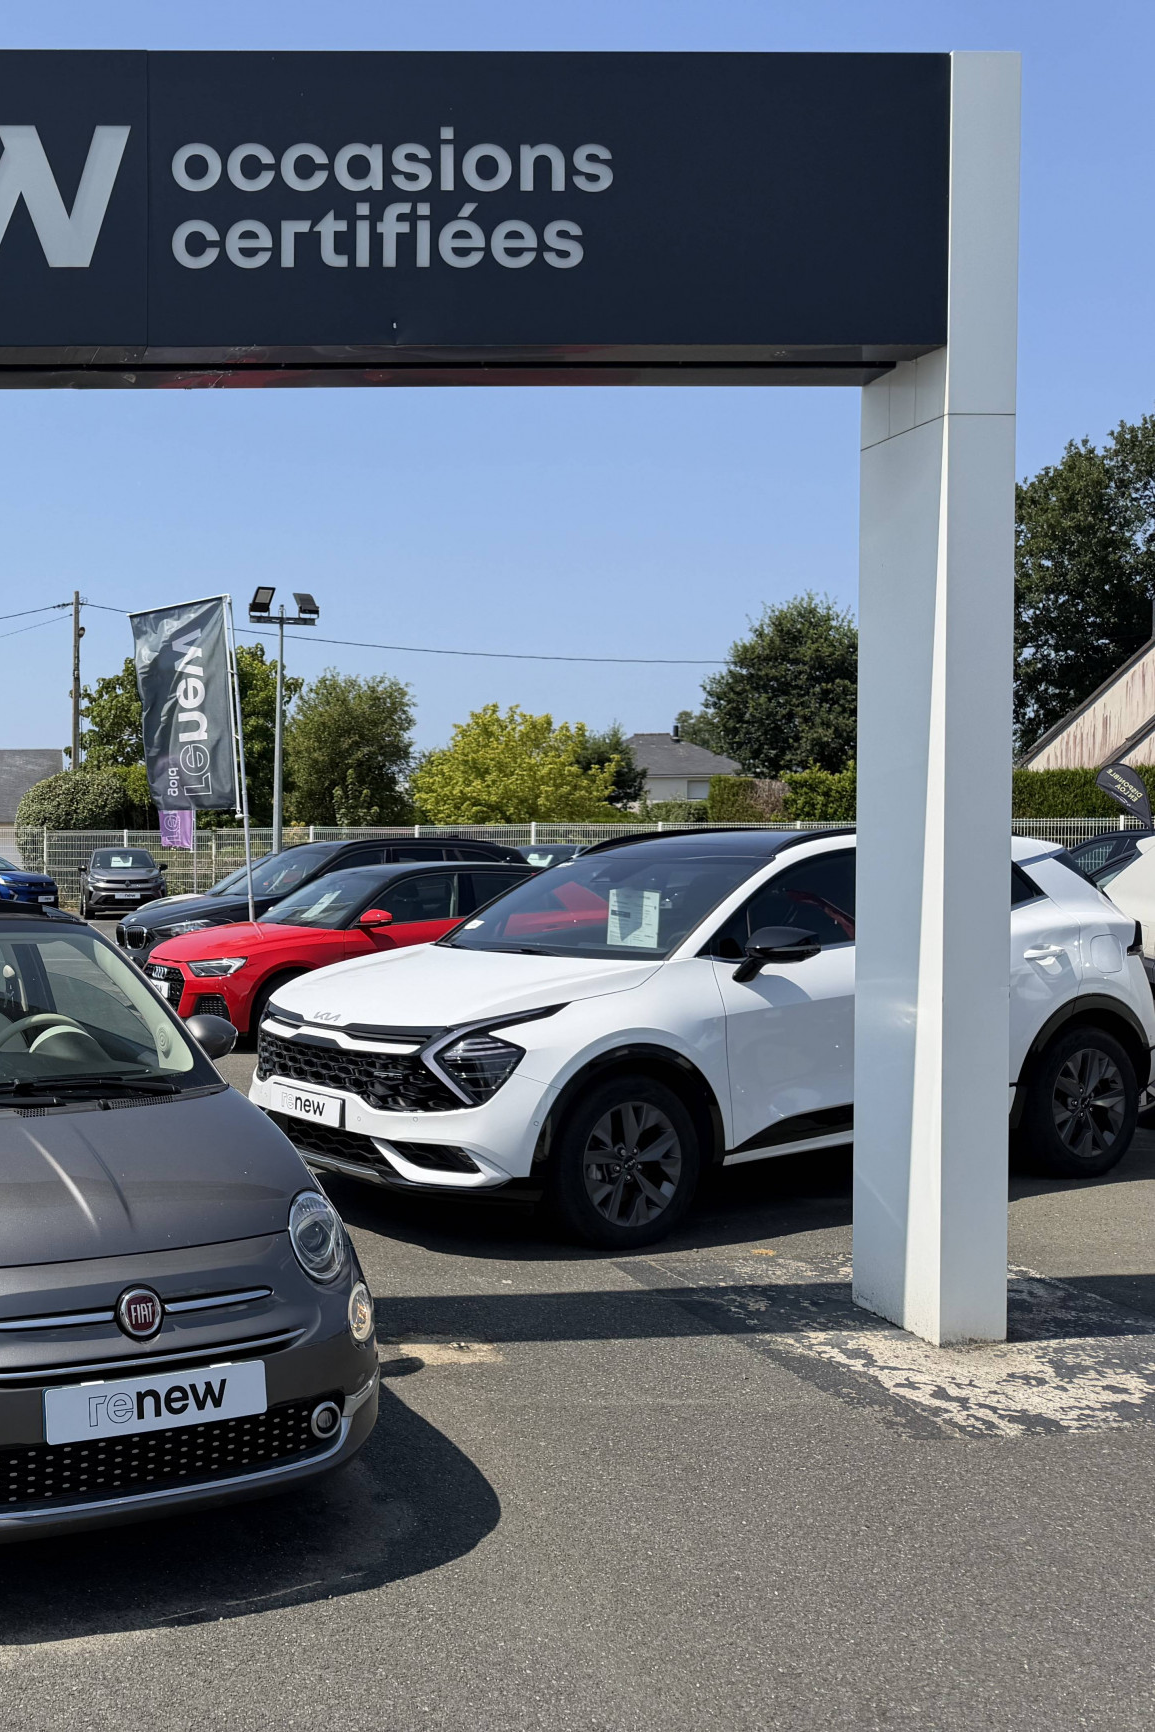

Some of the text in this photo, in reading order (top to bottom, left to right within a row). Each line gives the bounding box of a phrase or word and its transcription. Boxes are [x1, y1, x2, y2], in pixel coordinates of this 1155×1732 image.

[171, 126, 614, 193] occasions
[171, 202, 584, 269] certifiées
[281, 1092, 325, 1117] renew
[130, 1302, 153, 1325] FIAT
[88, 1378, 227, 1428] renew
